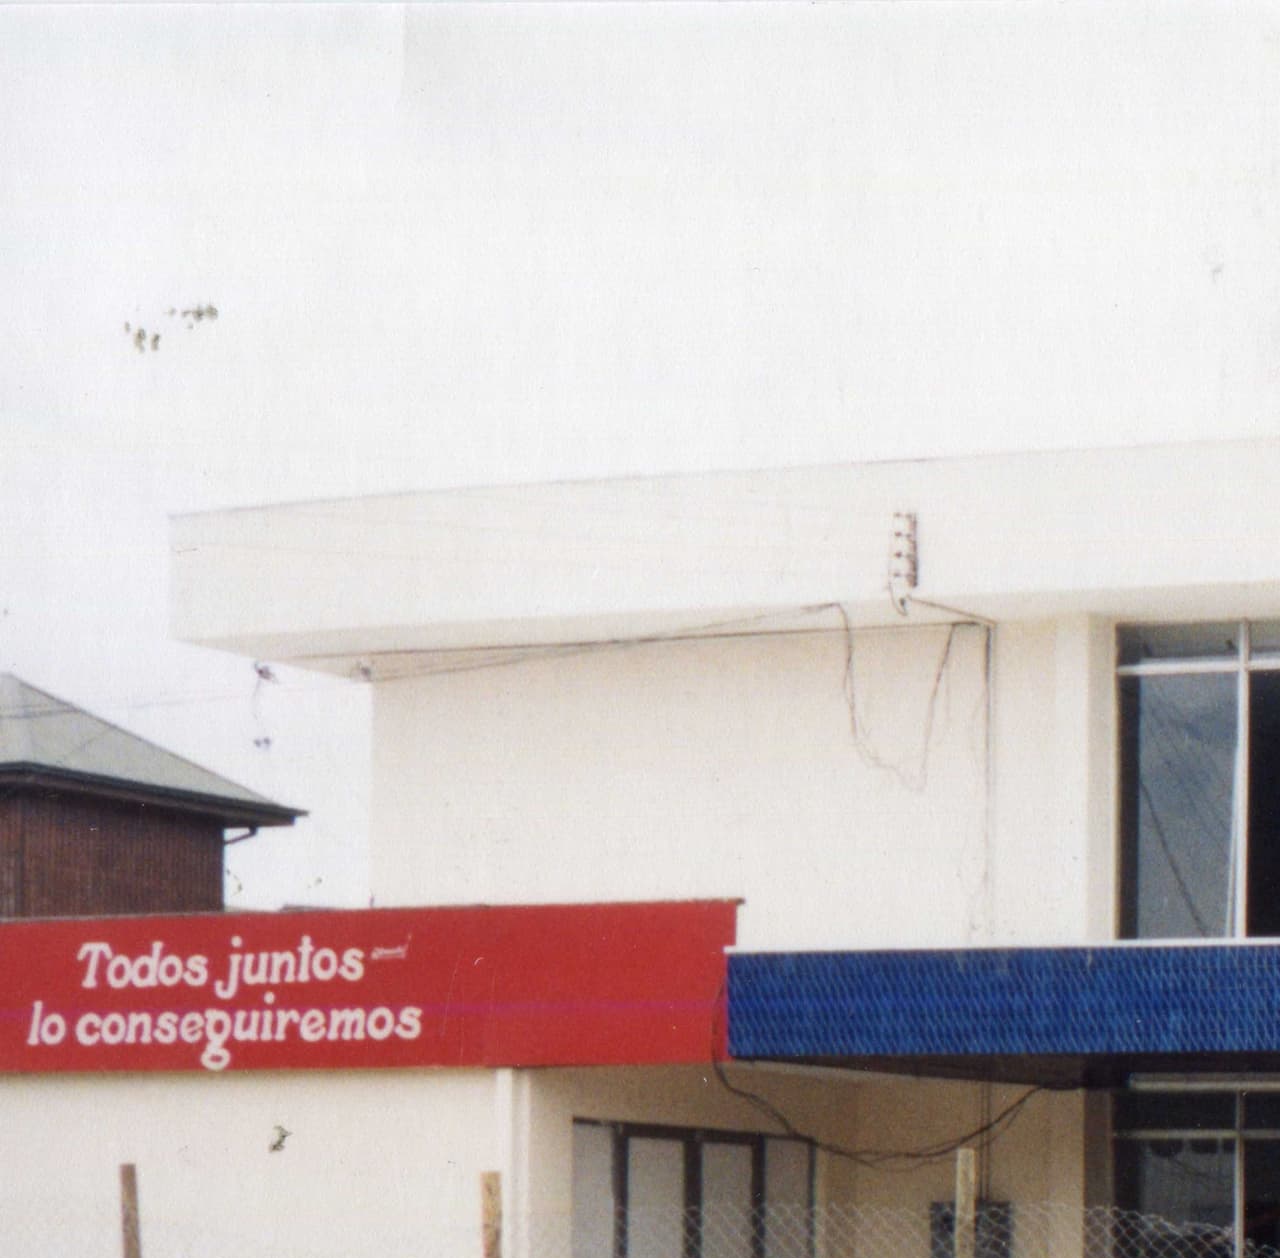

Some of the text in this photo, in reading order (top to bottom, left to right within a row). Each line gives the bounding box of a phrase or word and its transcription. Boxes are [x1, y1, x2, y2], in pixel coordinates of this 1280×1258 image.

[77, 936, 365, 999] Todos juntos
[27, 992, 422, 1071] lo conseguiremos
